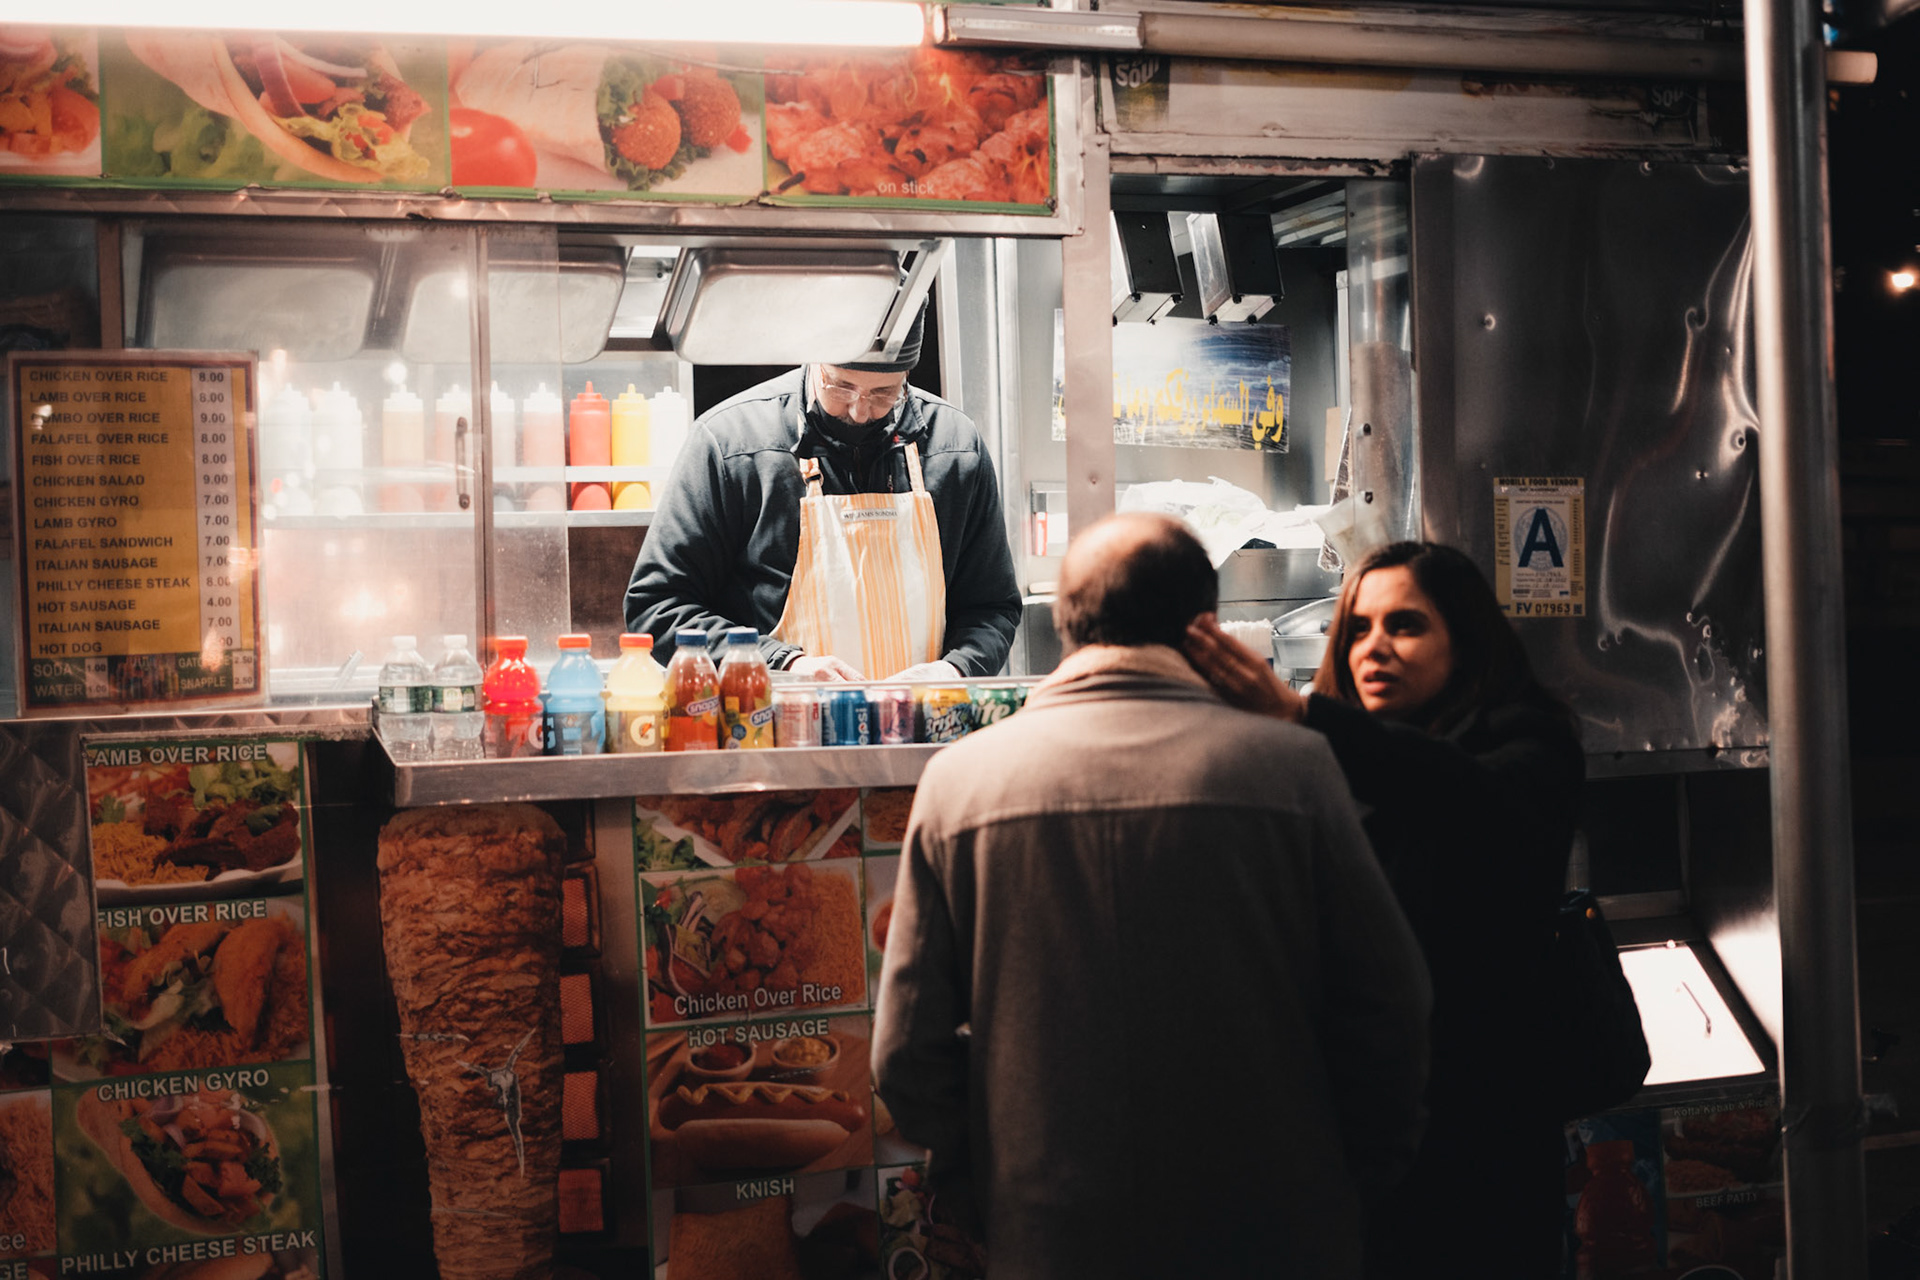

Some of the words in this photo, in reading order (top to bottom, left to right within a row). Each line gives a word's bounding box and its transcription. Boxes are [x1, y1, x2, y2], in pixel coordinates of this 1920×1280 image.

[878, 182, 896, 194] on
[901, 180, 935, 195] stick
[30, 370, 91, 382] CHICKEN
[95, 371, 134, 382] OVER
[137, 371, 168, 382] RICE
[199, 372, 224, 382] 8.00
[30, 392, 70, 403] LAMB
[73, 392, 111, 403] OVER
[115, 392, 146, 402] RICE
[199, 393, 224, 403] 8.00
[87, 413, 124, 424] OVER
[128, 413, 161, 423] RICE
[200, 413, 226, 424] 9.00
[31, 433, 91, 444] FALAFEL
[96, 434, 134, 444] OVER
[138, 434, 169, 444] RICE
[200, 434, 226, 444] 8.00
[32, 454, 63, 466] FISH
[66, 454, 105, 466] OVER
[109, 454, 141, 464] RICE
[202, 454, 227, 464] 8.00
[33, 476, 94, 487] CHICKEN
[99, 475, 145, 486] SALAD
[203, 474, 228, 485] 9.00
[1529, 478, 1548, 486] FOOD
[1551, 478, 1578, 486] VENDOR
[34, 496, 96, 508] CHICKEN
[100, 496, 140, 508] GYRO
[204, 495, 229, 506] 7.00
[34, 518, 74, 528] LAMB
[77, 517, 117, 528] GYRO
[205, 516, 230, 526] 7.00
[35, 538, 96, 550] FALAFEL
[100, 537, 174, 549] SANDWICH
[206, 536, 230, 546] 7.00
[1518, 508, 1564, 567] A
[36, 560, 88, 571] ITALIAN
[93, 558, 158, 570] SAUSAGE
[36, 581, 84, 592] PHILLY
[87, 579, 142, 590] CHEESE
[146, 578, 191, 588] STEAK
[38, 602, 66, 613] HOT
[70, 600, 136, 612] SAUSAGE
[207, 597, 232, 607] 4.00
[1516, 602, 1532, 614] FV
[1536, 603, 1570, 614] 07963
[38, 622, 91, 634] ITALIAN
[95, 620, 161, 632] SAUSAGE
[208, 617, 232, 628] 7.00
[40, 643, 68, 654] HOT
[72, 642, 102, 654] DOG
[34, 664, 72, 678] SODA
[87, 664, 106, 672] 1.00
[180, 676, 226, 690] SNAPPLE
[34, 684, 82, 698] WATER
[630, 716, 656, 746] G
[856, 708, 868, 745] epsi
[88, 748, 142, 766] AMB
[149, 746, 210, 764] OVER
[216, 744, 268, 762] RICE
[98, 908, 142, 928] FISH
[149, 904, 208, 926] OVER
[216, 900, 266, 920] RICE
[674, 992, 748, 1016] Chicken
[754, 987, 797, 1007] Over
[802, 983, 842, 1003] Rice
[688, 1028, 728, 1048] HOT
[735, 1019, 828, 1042] SAUSAGE
[98, 1075, 199, 1102] CHICKEN
[206, 1068, 270, 1091] GYRO
[736, 1178, 794, 1200] KNISH
[1696, 1196, 1724, 1208] BEEF
[1726, 1192, 1757, 1203] PATTY
[61, 1250, 139, 1274] PHILLY
[146, 1239, 236, 1266] CHEESE
[243, 1230, 316, 1256] STEAK
